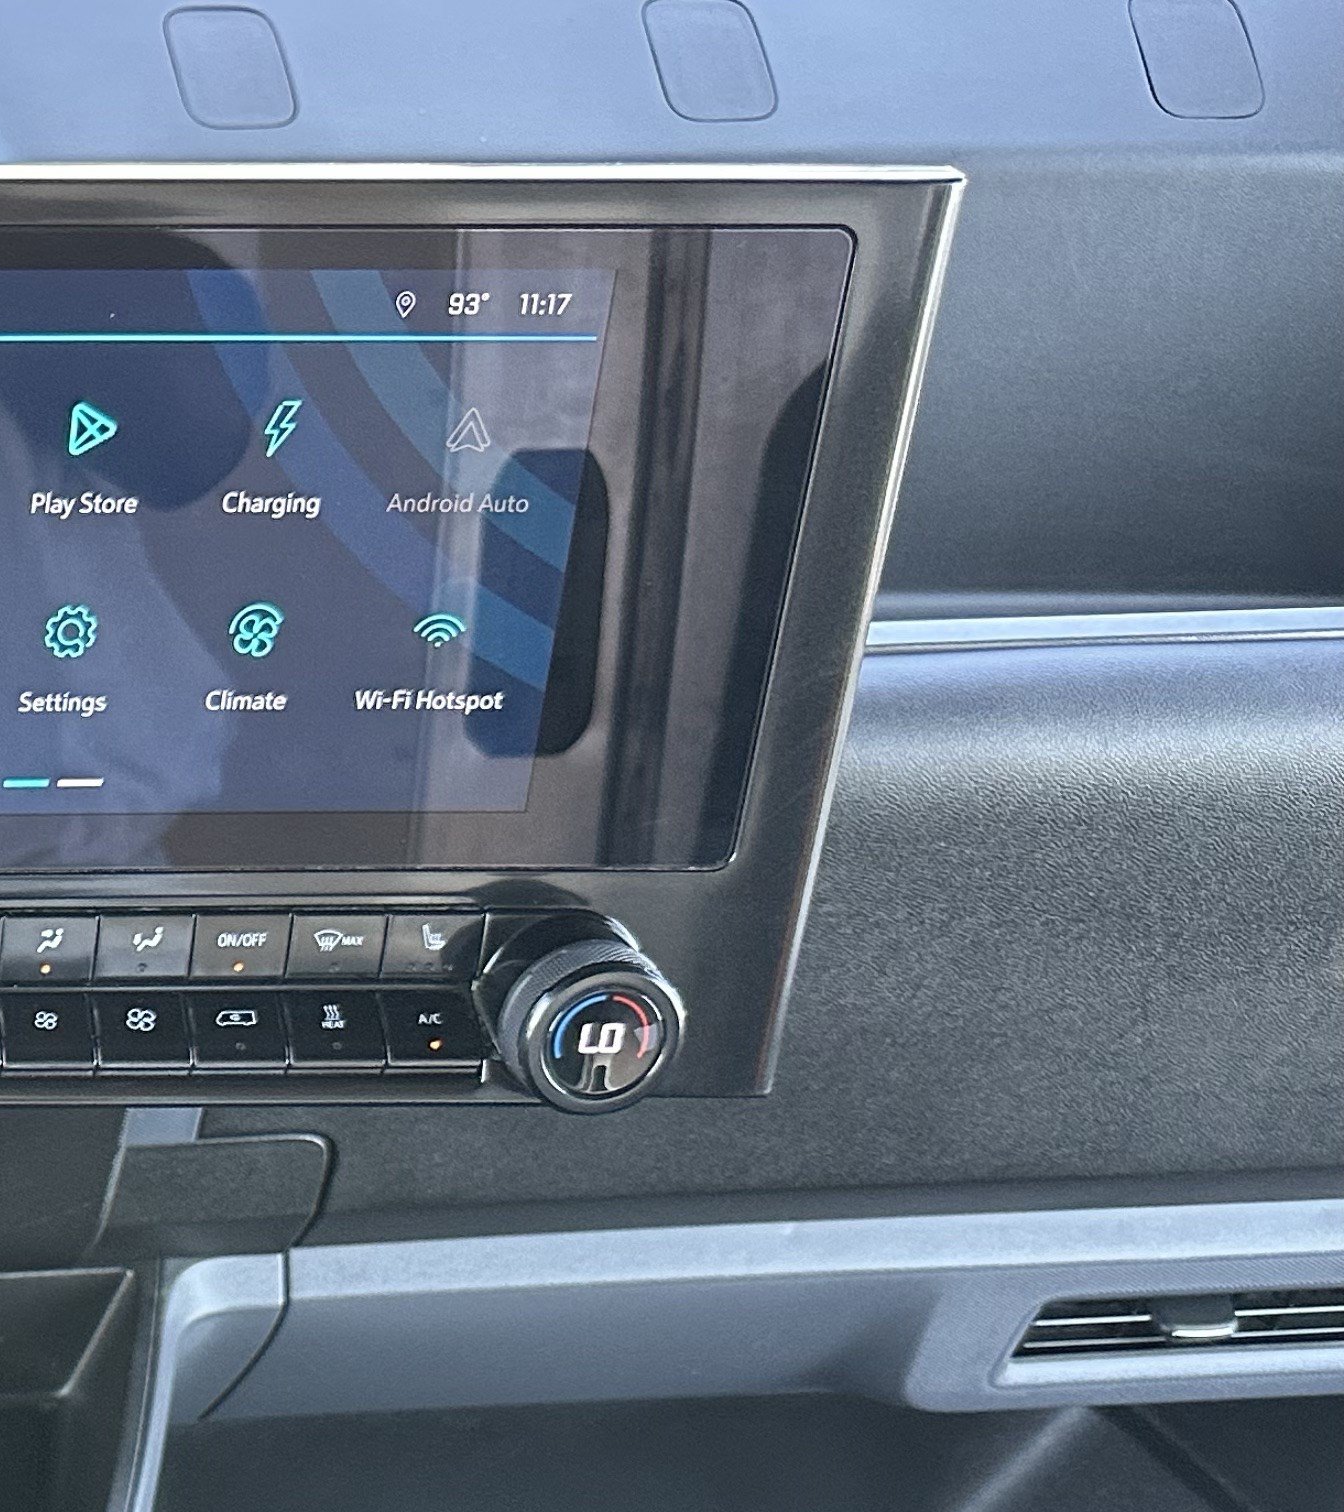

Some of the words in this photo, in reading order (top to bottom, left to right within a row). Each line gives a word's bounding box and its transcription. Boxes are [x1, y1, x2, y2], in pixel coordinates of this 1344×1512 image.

[448, 292, 491, 316] 93°
[520, 293, 573, 316] 11:17
[30, 490, 77, 520] Play
[78, 492, 139, 514] Store
[222, 490, 322, 519] Charging
[385, 491, 475, 513] Android
[476, 493, 529, 513] Auto
[17, 691, 107, 718] Settings
[205, 689, 287, 711] Climate
[355, 689, 414, 710] Wi-Fi
[415, 689, 504, 715] Hotspot
[217, 932, 267, 948] ON/OFF
[341, 935, 365, 946] MAX
[321, 1020, 346, 1029] HEAT
[418, 1013, 442, 1025] A/C
